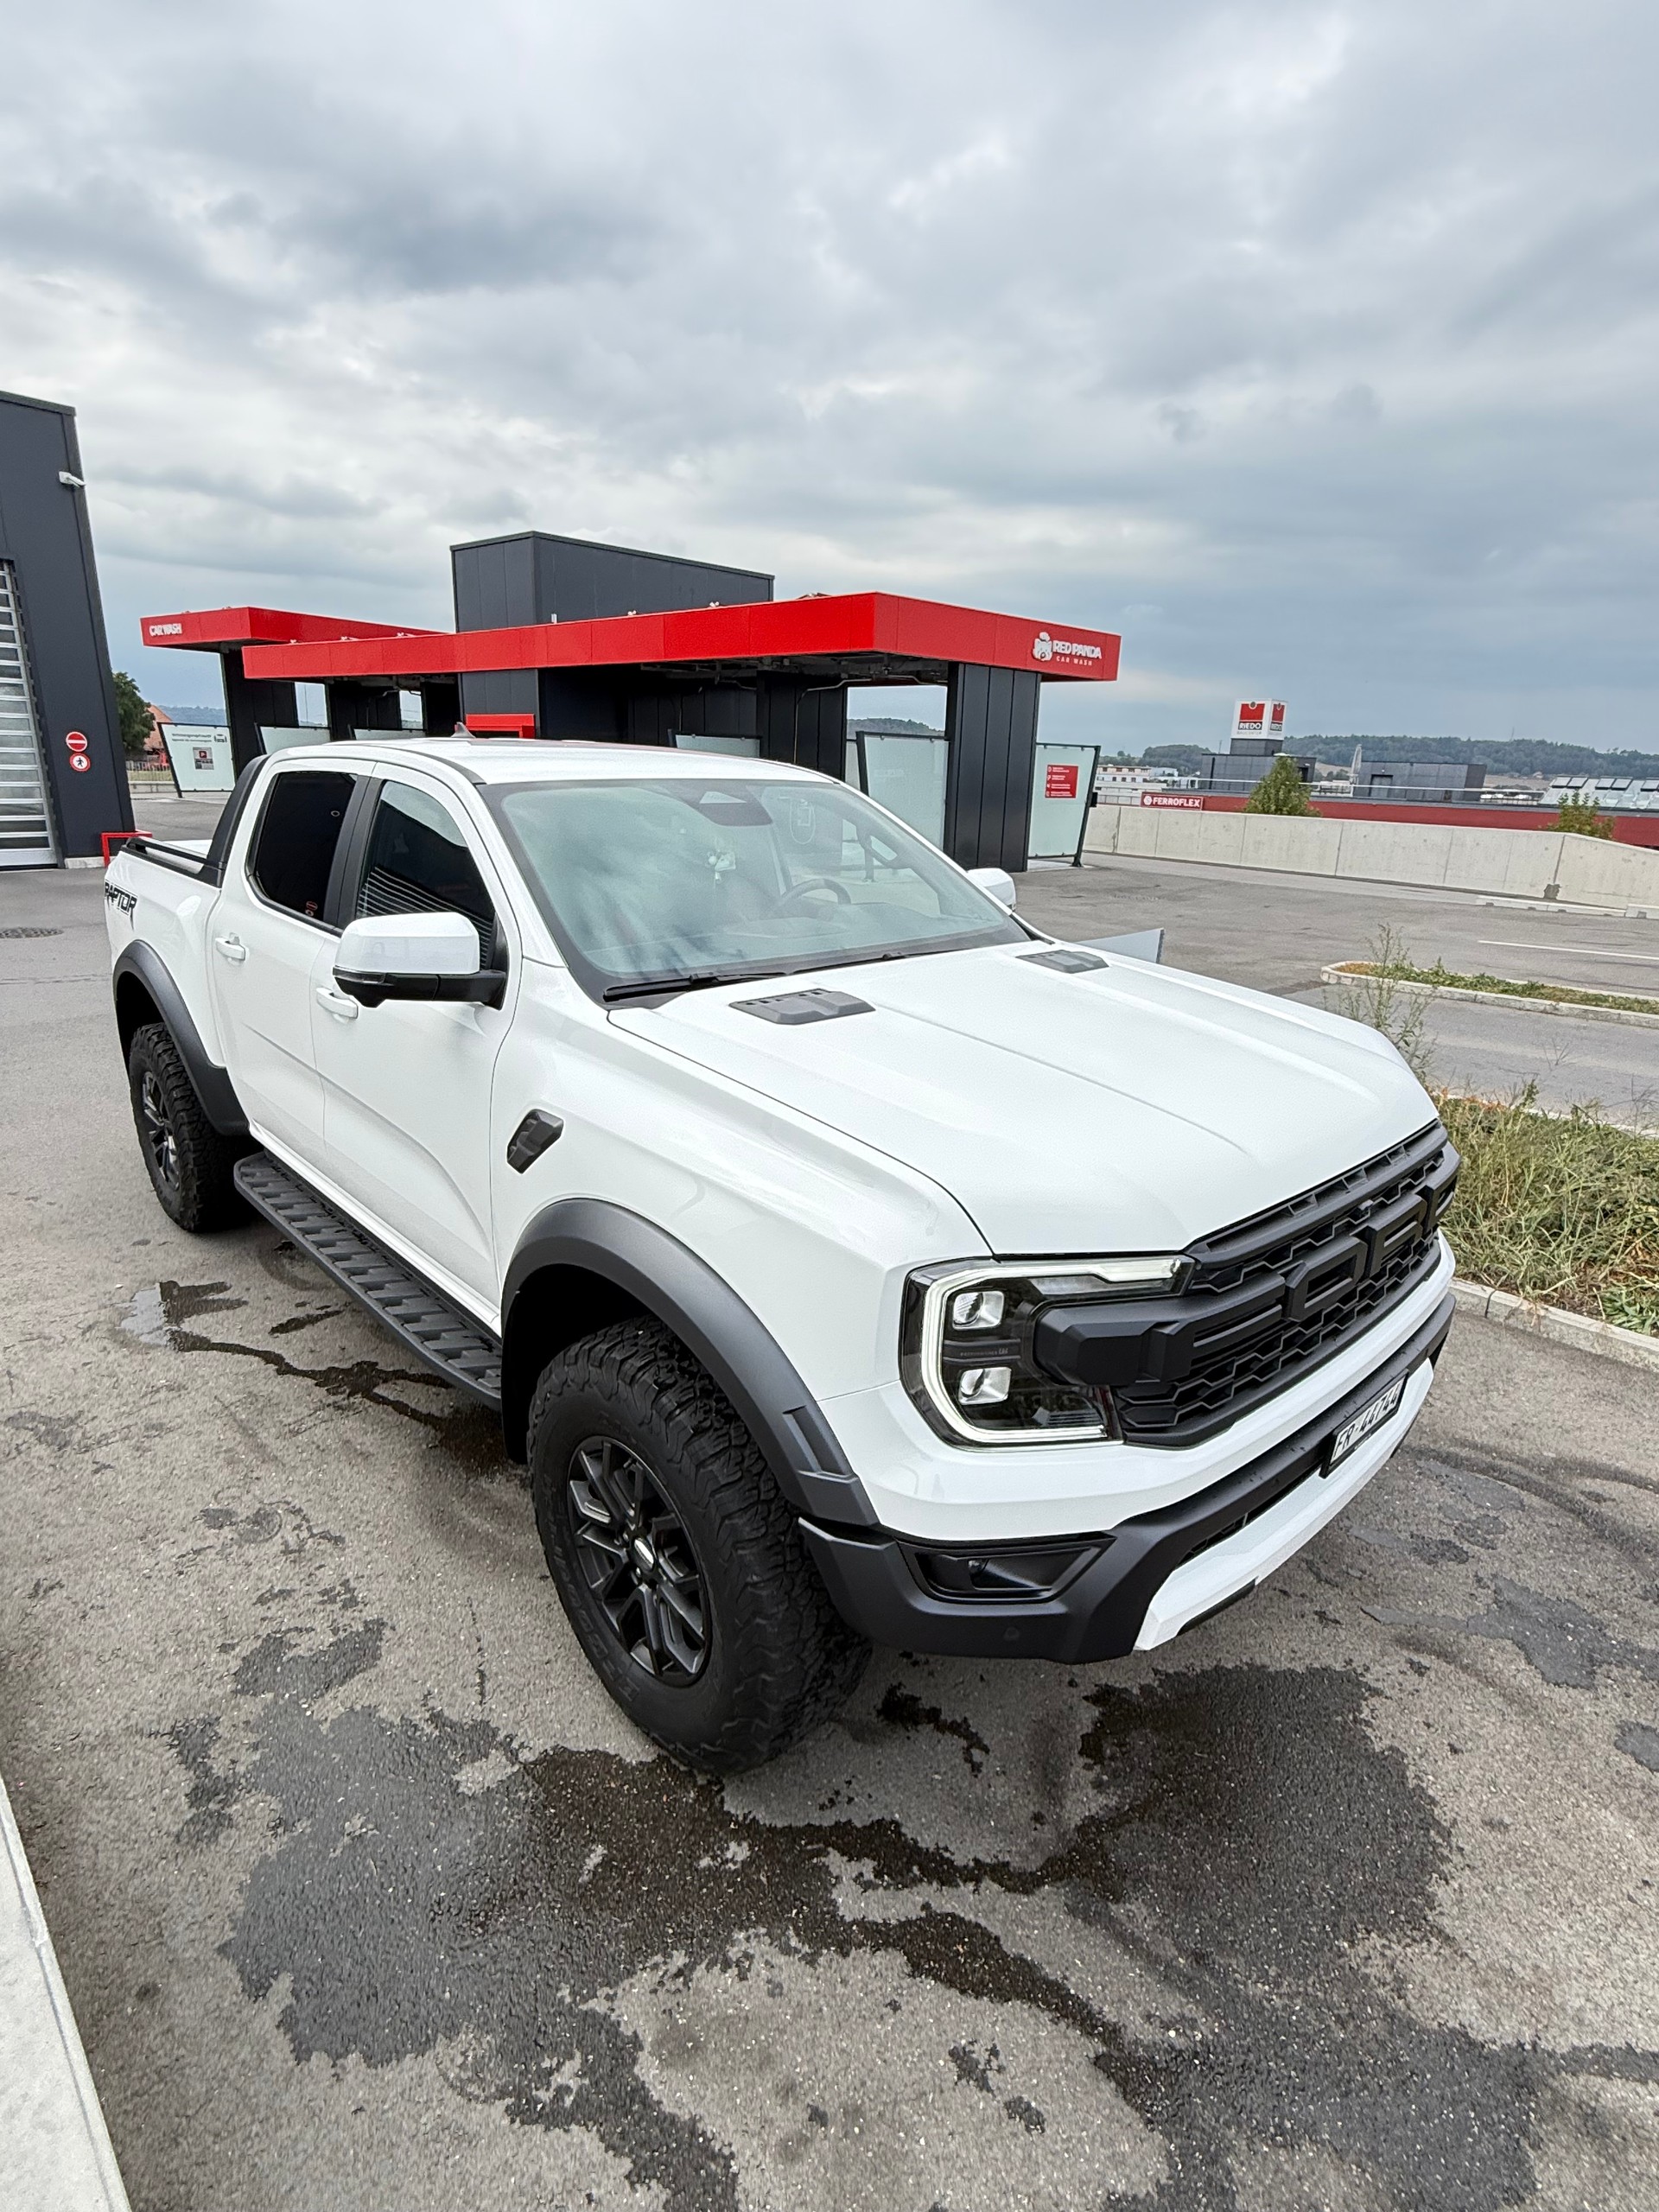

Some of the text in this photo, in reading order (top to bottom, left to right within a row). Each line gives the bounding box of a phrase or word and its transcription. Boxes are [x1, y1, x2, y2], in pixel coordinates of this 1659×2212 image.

[149, 623, 182, 636] CAR WASH
[1052, 640, 1102, 659] RED PANDA
[1152, 797, 1200, 807] FERROFLEX
[105, 880, 138, 931] RAPTOR
[1136, 1182, 1456, 1384] FORD
